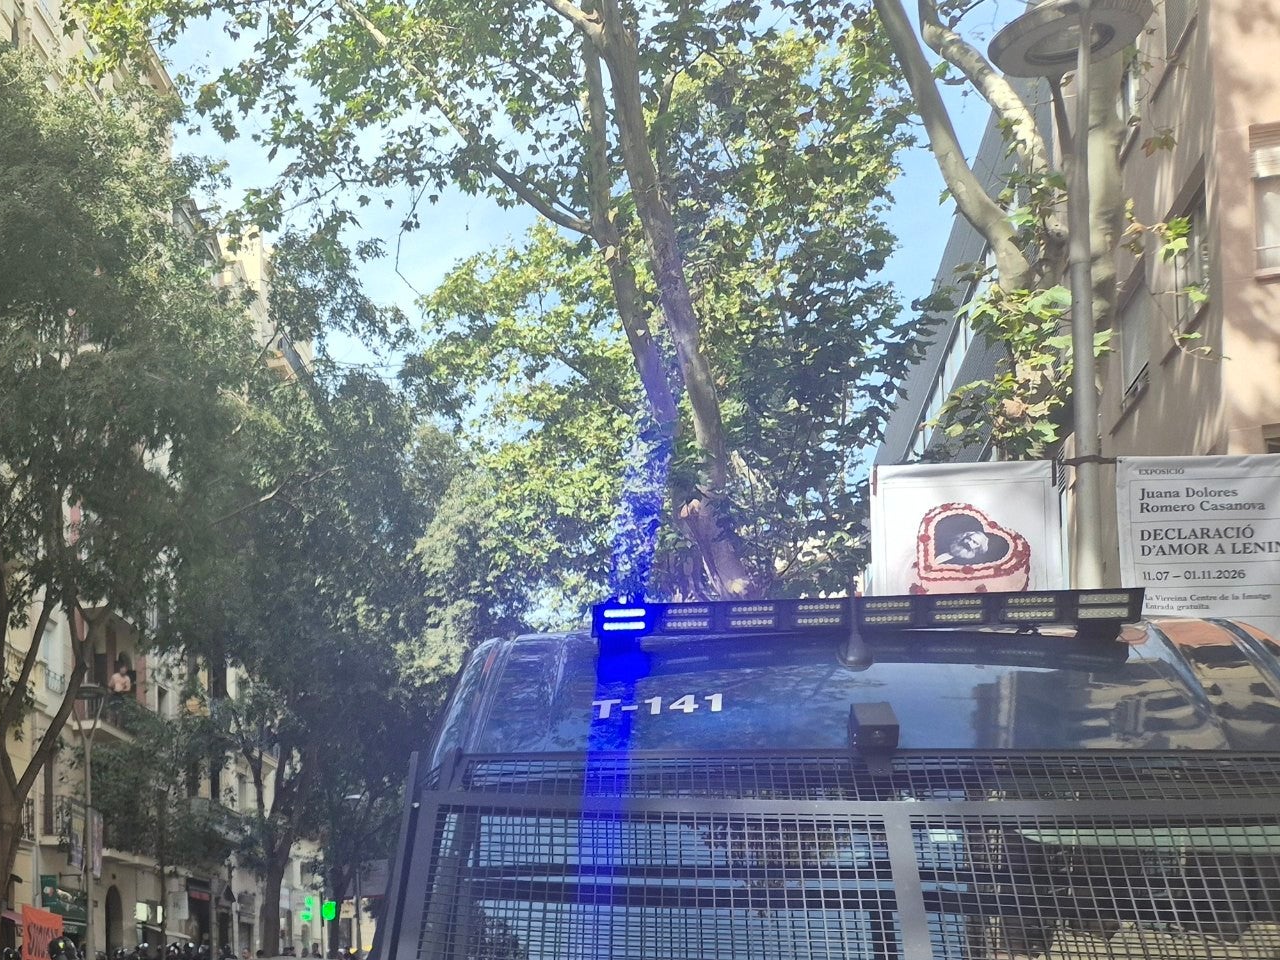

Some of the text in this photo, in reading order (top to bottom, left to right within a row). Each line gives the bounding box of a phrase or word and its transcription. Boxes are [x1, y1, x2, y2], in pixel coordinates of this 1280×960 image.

[1138, 467, 1185, 476] EXPOSICIÓ
[1140, 486, 1239, 500] Juana Dolores
[1140, 500, 1266, 513] Romero Casanova
[1140, 524, 1255, 541] DECLARACIÓ
[1214, 543, 1226, 555] A
[1142, 571, 1170, 581] 11.07
[1184, 569, 1246, 580] 01.11.2026
[1154, 594, 1187, 602] Virreina
[1231, 592, 1239, 600] la
[592, 693, 723, 719] T-141
